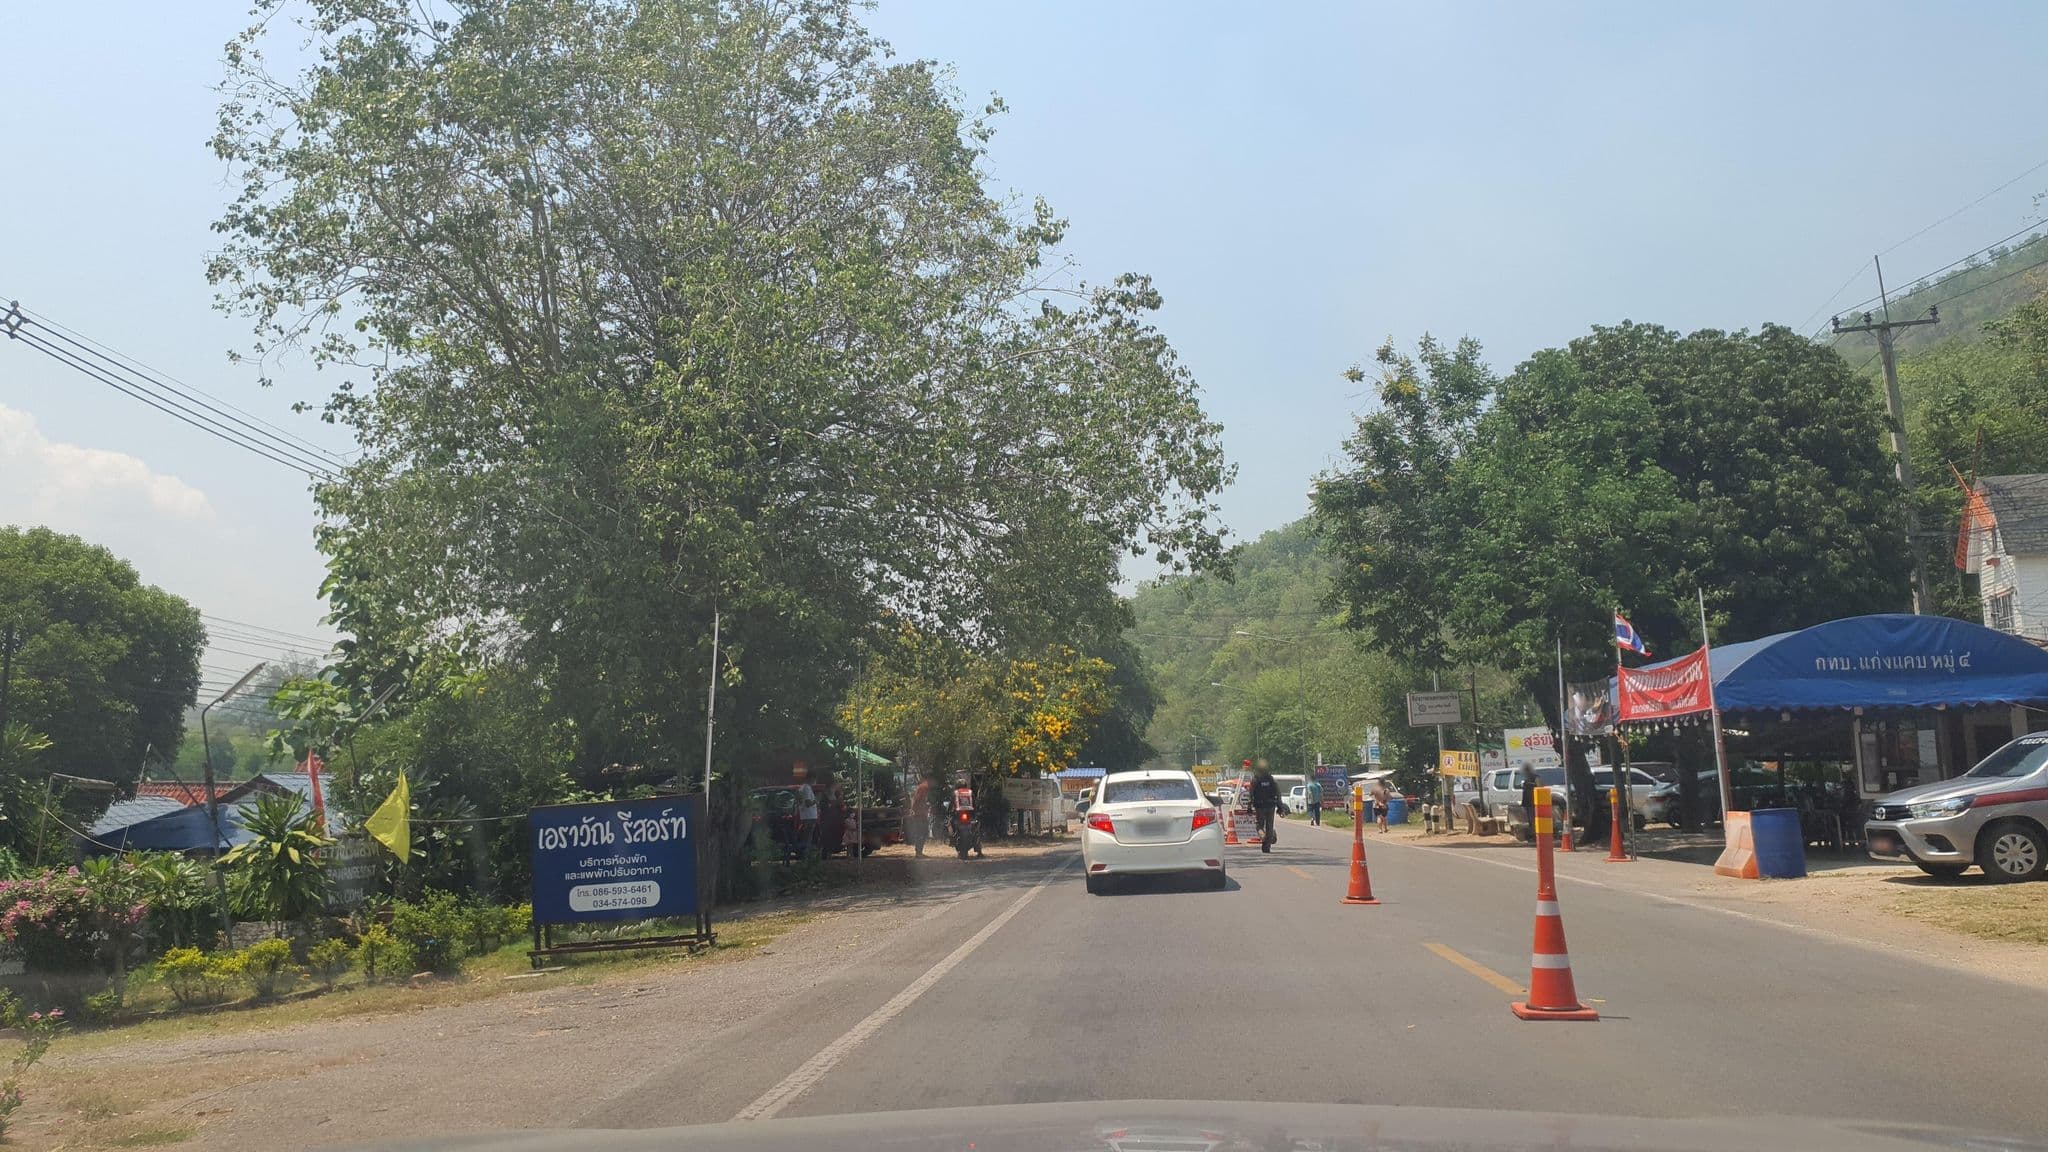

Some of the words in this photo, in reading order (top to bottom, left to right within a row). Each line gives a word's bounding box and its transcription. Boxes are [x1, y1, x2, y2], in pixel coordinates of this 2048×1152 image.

[538, 816, 615, 850] เอราวัณ
[617, 808, 687, 844] รีสอร์ท
[579, 854, 647, 868] บริการห้องพัก
[565, 865, 663, 881] และแพพักปรับอากาศ
[592, 897, 648, 908] 034-574-098
